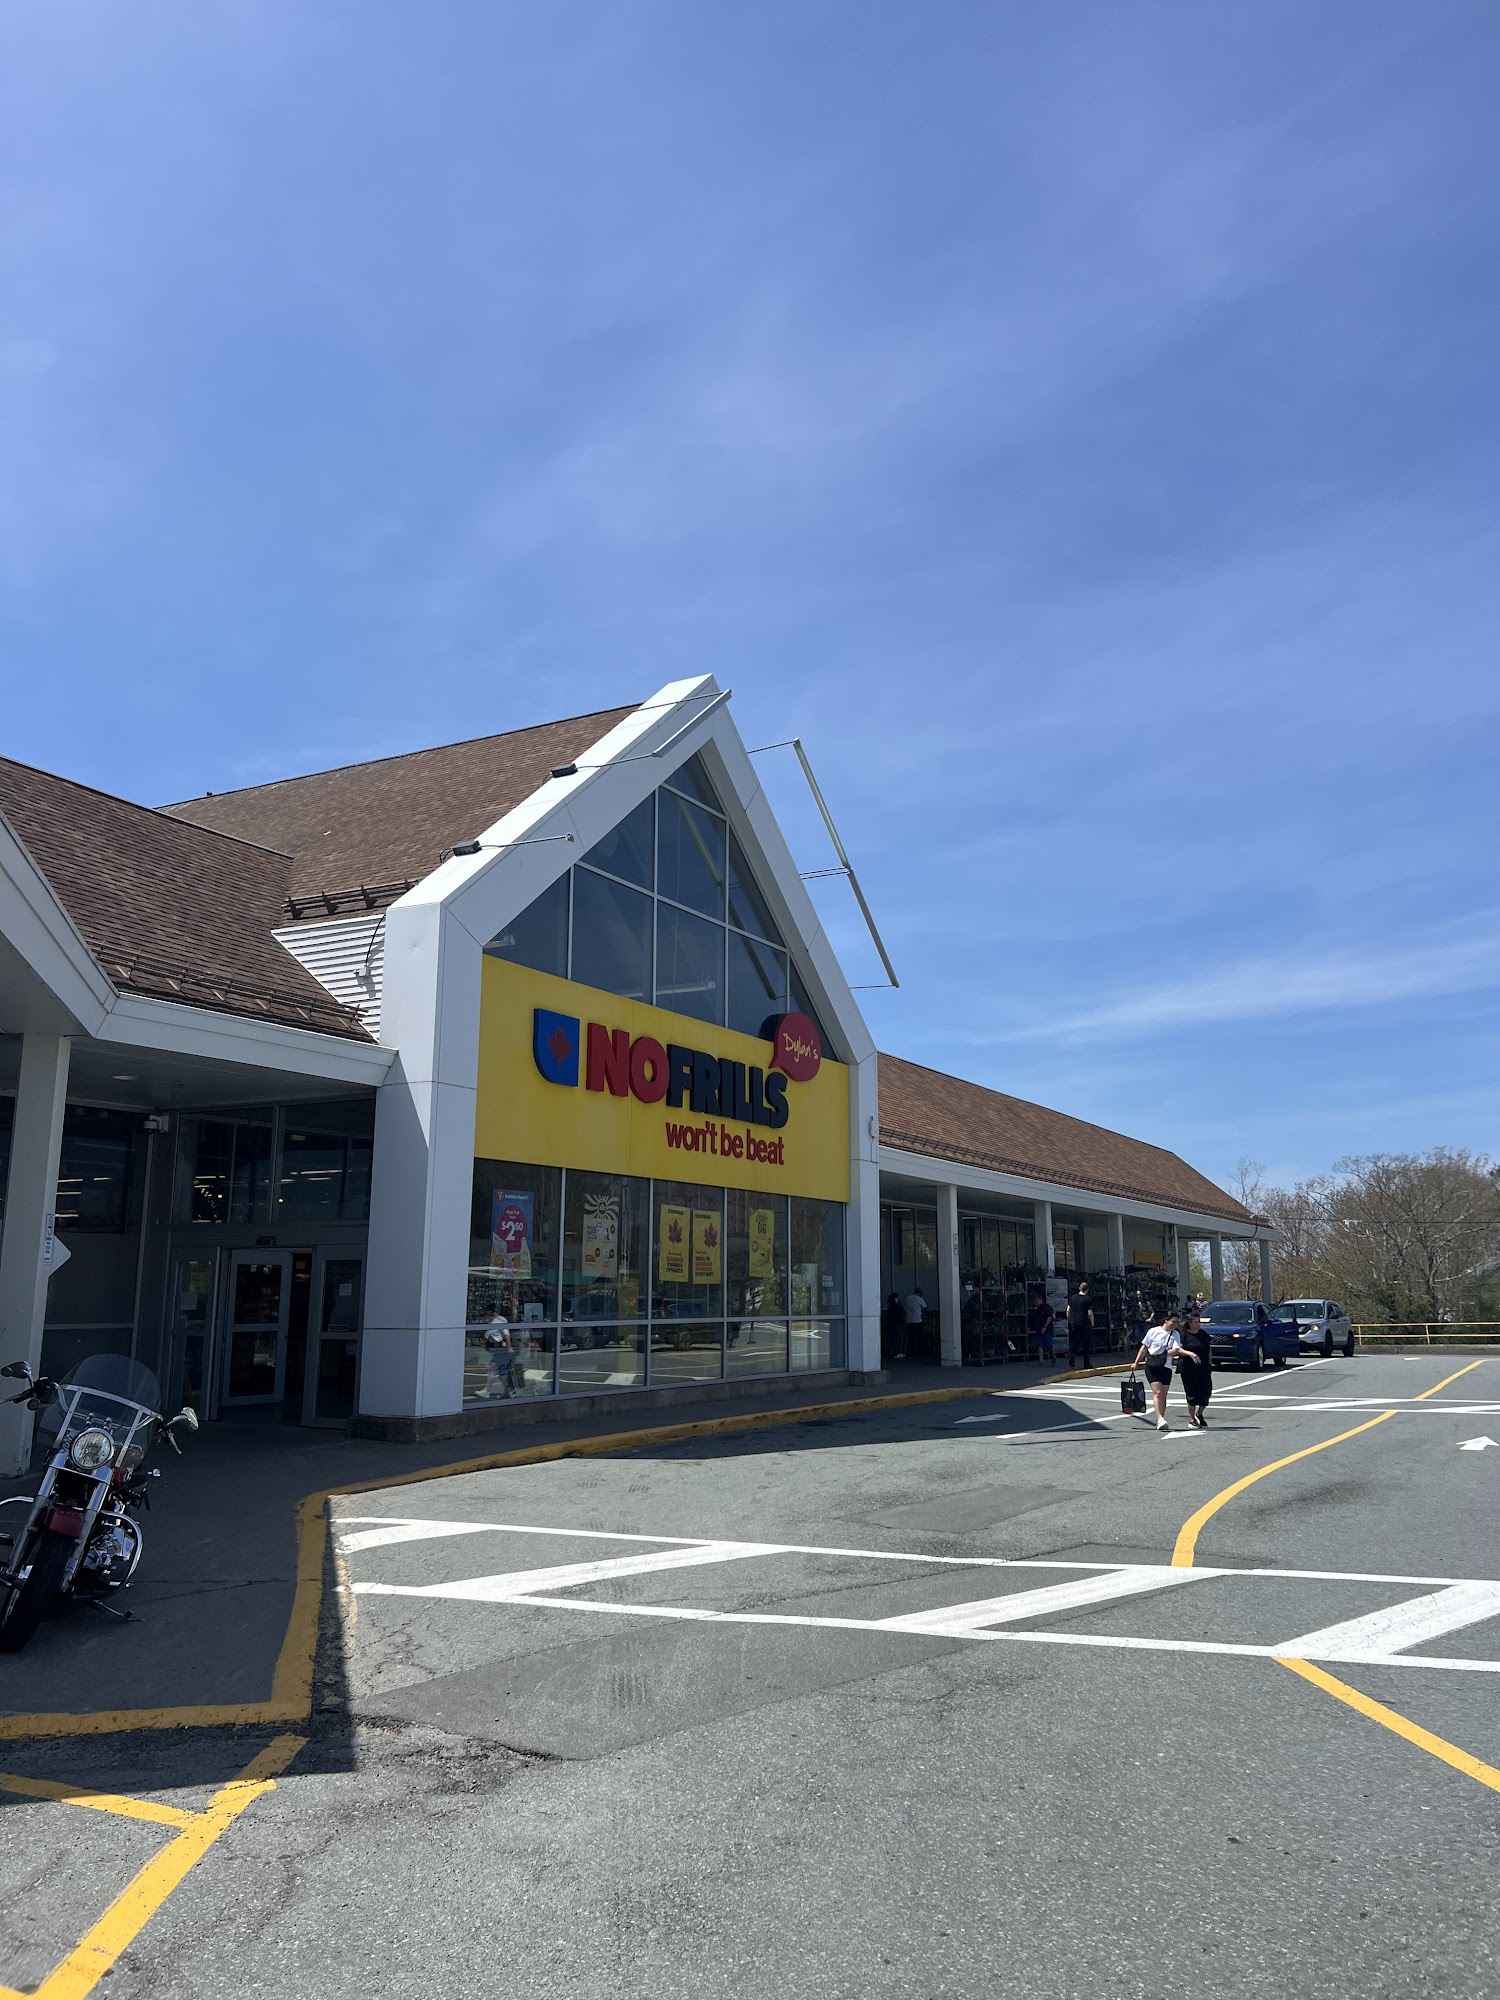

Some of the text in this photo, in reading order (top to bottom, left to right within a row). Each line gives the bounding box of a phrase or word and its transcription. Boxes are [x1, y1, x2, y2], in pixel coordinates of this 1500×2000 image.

[782, 1032, 819, 1063] Dylan's
[665, 1121, 785, 1166] won't be beat
